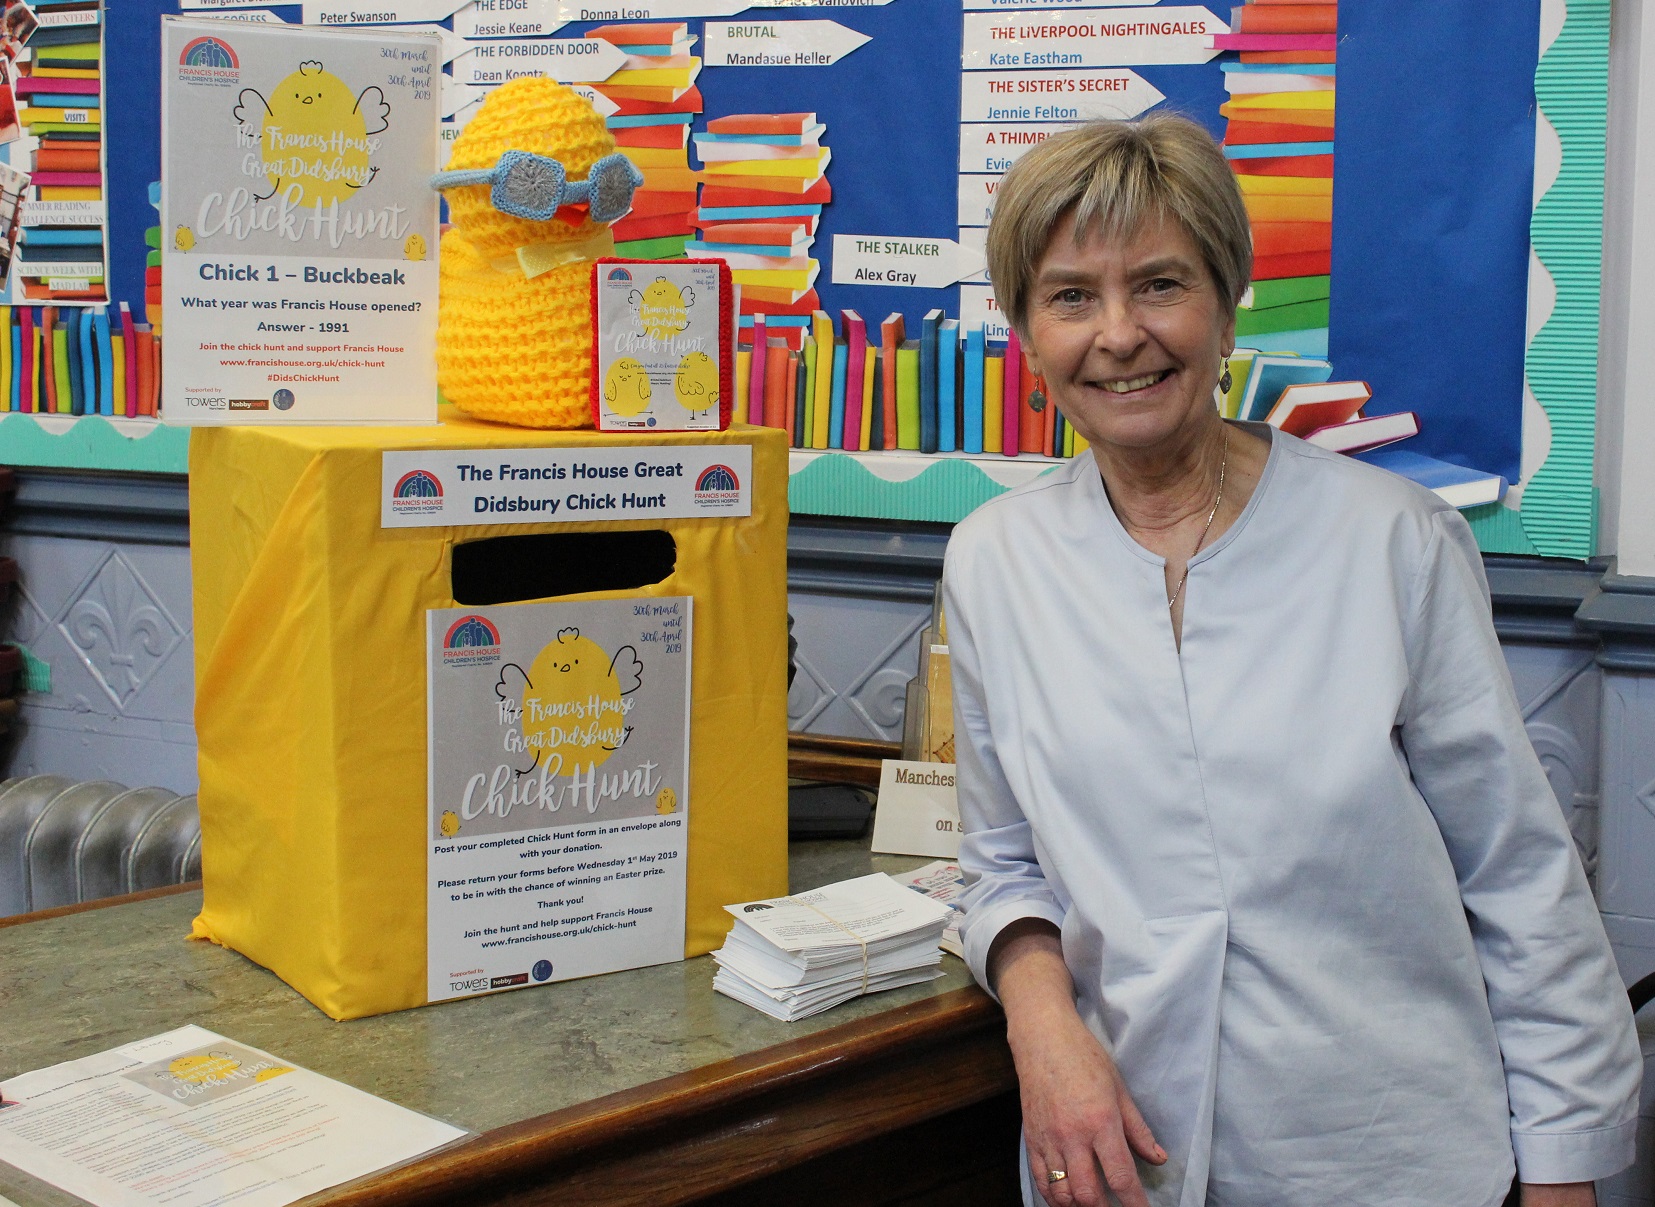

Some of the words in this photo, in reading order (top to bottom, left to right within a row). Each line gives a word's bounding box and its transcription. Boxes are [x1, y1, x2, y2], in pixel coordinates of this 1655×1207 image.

[475, 0, 495, 11] THE
[500, 0, 528, 10] EDGE
[40, 13, 95, 24] VOLUNTEERS
[320, 13, 348, 23] Peter
[350, 12, 396, 23] Swanson
[580, 9, 618, 20] Donna
[622, 8, 650, 19] Leon
[474, 23, 506, 35] Jessie
[509, 22, 542, 34] Keane
[728, 26, 777, 38] BRUTAL
[990, 27, 1016, 40] THE
[1020, 25, 1097, 39] LIVERPOOL
[1101, 22, 1206, 37] NIGHTINGALES
[401, 50, 428, 60] March
[474, 46, 495, 57] THE
[499, 44, 564, 56] FORBIDDEN
[568, 43, 600, 55] DOOR
[726, 53, 791, 65] Mandasue
[795, 52, 832, 64] Heller
[990, 53, 1020, 66] Kate
[1024, 51, 1082, 65] Eastham
[179, 68, 212, 77] FRANCIS
[214, 70, 240, 78] HOUSE
[411, 64, 432, 75] until
[474, 70, 502, 81] Dean
[408, 77, 432, 89] April
[988, 80, 1014, 93] THE
[1018, 79, 1075, 92] SISTER’S
[1079, 78, 1130, 92] SECRET
[414, 90, 431, 100] 2019
[987, 107, 1030, 120] Jennie
[1034, 106, 1078, 118] Felton
[233, 123, 262, 149] The
[266, 126, 328, 153] Francis
[326, 130, 382, 156] House
[986, 133, 996, 145] A
[241, 152, 289, 178] Great
[288, 156, 373, 186] Didsbury
[54, 202, 90, 210] READING
[68, 216, 104, 224] SUCCESS
[197, 182, 307, 242] Chick
[306, 196, 410, 250] Hunt
[856, 241, 880, 254] THE
[884, 242, 939, 256] STALKER
[199, 263, 260, 282] Chick
[266, 265, 280, 282] 1
[304, 266, 406, 285] Buckbeak
[855, 268, 883, 280] Alex
[886, 270, 917, 286] Gray
[181, 297, 218, 309] What
[221, 300, 248, 311] year
[252, 300, 277, 310] was
[281, 300, 325, 310] Francis
[330, 300, 368, 312] House
[371, 302, 422, 314] opened?
[257, 321, 306, 332] Answer
[318, 322, 350, 333] 1991
[200, 342, 218, 351] Join
[220, 343, 236, 351] the
[238, 343, 261, 351] chick
[264, 343, 285, 352] hunt
[287, 344, 304, 352] and
[306, 344, 341, 354] support
[344, 344, 374, 352] Francis
[377, 344, 404, 353] House
[614, 328, 661, 354] Chick
[662, 333, 707, 357] Hunt
[220, 358, 385, 368] www.francishouse.org.uk/chick-hunt
[267, 374, 340, 382] #DidsChickHunt
[231, 401, 266, 409] hobbycraft
[456, 464, 492, 482] The
[500, 463, 566, 481] Francis
[572, 463, 628, 480] House
[634, 462, 683, 478] Great
[474, 496, 560, 514] Didsbury
[566, 493, 616, 510] Chick
[622, 492, 666, 508] Hunt
[653, 602, 679, 616] March
[662, 616, 682, 628] until
[660, 629, 682, 643] April
[444, 650, 474, 658] FRANCIS
[476, 648, 500, 656] HOUSE
[666, 643, 682, 654] 2019
[495, 698, 523, 726] The
[526, 697, 585, 723] Francis
[584, 694, 636, 716] House
[504, 728, 548, 754] Great
[548, 720, 628, 748] Didsbury
[895, 768, 956, 787] Manches
[461, 752, 566, 821] Chick
[566, 760, 662, 814] Hunt
[936, 819, 953, 832] on
[434, 846, 454, 854] Post
[457, 843, 478, 853] your
[480, 836, 524, 849] completed
[528, 832, 551, 843] Chick
[553, 831, 574, 840] Hunt
[576, 830, 596, 838] form
[598, 827, 607, 835] in
[621, 822, 657, 832] envelope
[659, 820, 682, 828] along
[520, 850, 539, 858] with
[542, 848, 561, 858] your
[563, 843, 603, 854] donation.
[438, 879, 466, 888] Please
[468, 875, 496, 885] return
[498, 872, 518, 882] your
[520, 868, 545, 878] forms
[548, 866, 574, 875] before
[576, 858, 626, 871] Wednesday
[640, 855, 656, 864] May
[658, 851, 678, 860] 2019
[451, 894, 460, 902] to
[463, 892, 474, 900] be
[476, 890, 484, 898] in
[486, 888, 506, 898] with
[508, 886, 522, 894] the
[525, 882, 554, 892] chance
[556, 880, 566, 888] of
[568, 876, 601, 886] winning
[616, 870, 642, 880] Easter
[643, 868, 666, 878] prize.
[538, 898, 564, 909] Thank
[564, 896, 584, 907] you!
[464, 930, 482, 939] Join
[484, 927, 498, 937] the
[500, 924, 520, 934] hunt
[522, 921, 538, 930] and
[540, 918, 559, 930] help
[561, 914, 594, 926] support
[596, 909, 625, 920] Francis
[628, 906, 652, 916] House
[481, 920, 637, 949] www.francishouse.org.uk/chick-hunt
[450, 969, 476, 978] Supported
[172, 1074, 228, 1100] Chick
